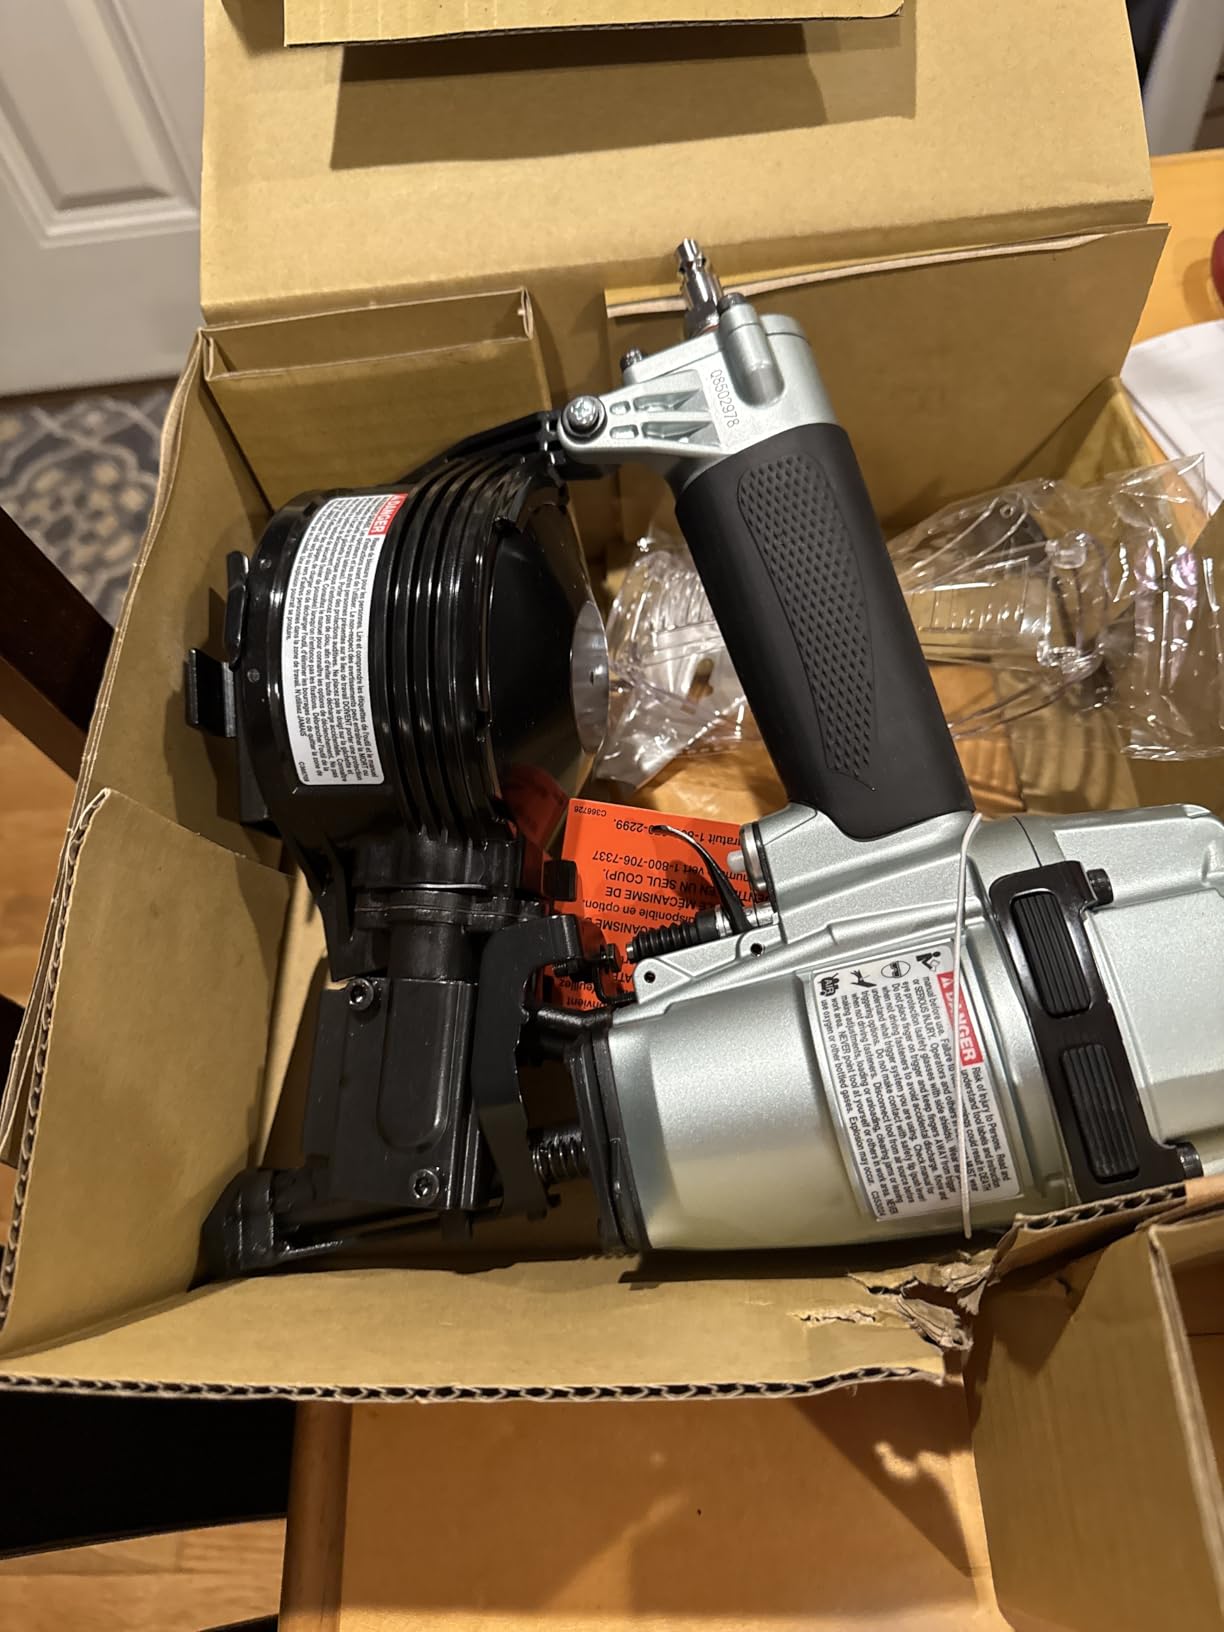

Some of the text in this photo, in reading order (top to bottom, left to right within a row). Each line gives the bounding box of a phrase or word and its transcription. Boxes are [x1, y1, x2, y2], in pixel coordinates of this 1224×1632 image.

[371, 500, 401, 532] DANGER
[591, 849, 679, 873] 1-800-706-7337
[682, 864, 704, 875] vert
[601, 867, 643, 884] COUP).
[645, 875, 676, 889] SEUL
[604, 885, 621, 898] DE
[623, 888, 696, 912] MÉCANISME
[581, 897, 619, 913] option.
[622, 905, 635, 915] en
[824, 978, 834, 993] AIR
[880, 986, 892, 1002] when
[899, 980, 910, 993] eye
[922, 975, 935, 997] manual
[819, 999, 827, 1010] use
[828, 997, 840, 1012] work
[837, 994, 852, 1016] making
[849, 992, 861, 1008] when
[858, 990, 874, 1019] triggering
[870, 988, 886, 1022] understand
[884, 1001, 895, 1013] not
[893, 992, 903, 1003] not
[914, 985, 929, 1013] SERIOUS
[928, 997, 942, 1020] before
[854, 1008, 864, 1019] not
[894, 1003, 908, 1022] place
[902, 992, 921, 1026] protection
[820, 1010, 833, 1034] oxygen
[833, 1012, 842, 1029] area.
[855, 1020, 870, 1042] driving
[879, 1022, 891, 1040] what
[886, 1013, 901, 1036] driving
[921, 1013, 936, 1040] INJURY.
[934, 1020, 944, 1036] use.
[837, 1030, 850, 1054] NEVER
[843, 1016, 863, 1060] adjustments,
[865, 1018, 881, 1046] options.
[899, 1022, 914, 1042] finger
[830, 1042, 842, 1062] other
[862, 1042, 879, 1079] fasteners.
[882, 1040, 897, 1064] trigger
[894, 1036, 910, 1070] fasteners
[928, 1042, 947, 1080] Operators
[940, 1038, 954, 1062] Failure
[834, 1062, 848, 1088] bottled
[841, 1054, 855, 1074] point
[854, 1060, 870, 1087] loading
[878, 1059, 888, 1073] not
[908, 1053, 924, 1078] trigger
[919, 1052, 936, 1081] glasses
[971, 1066, 983, 1082] Risk
[848, 1074, 859, 1089] tool
[881, 1072, 894, 1094] make
[888, 1064, 905, 1092] system
[917, 1078, 928, 1093] and
[940, 1080, 951, 1094] and
[960, 1068, 979, 1110] understand
[839, 1089, 853, 1113] gases.
[906, 1080, 919, 1101] avoid
[929, 1082, 941, 1098] with
[872, 1081, 891, 1122] Disconnect
